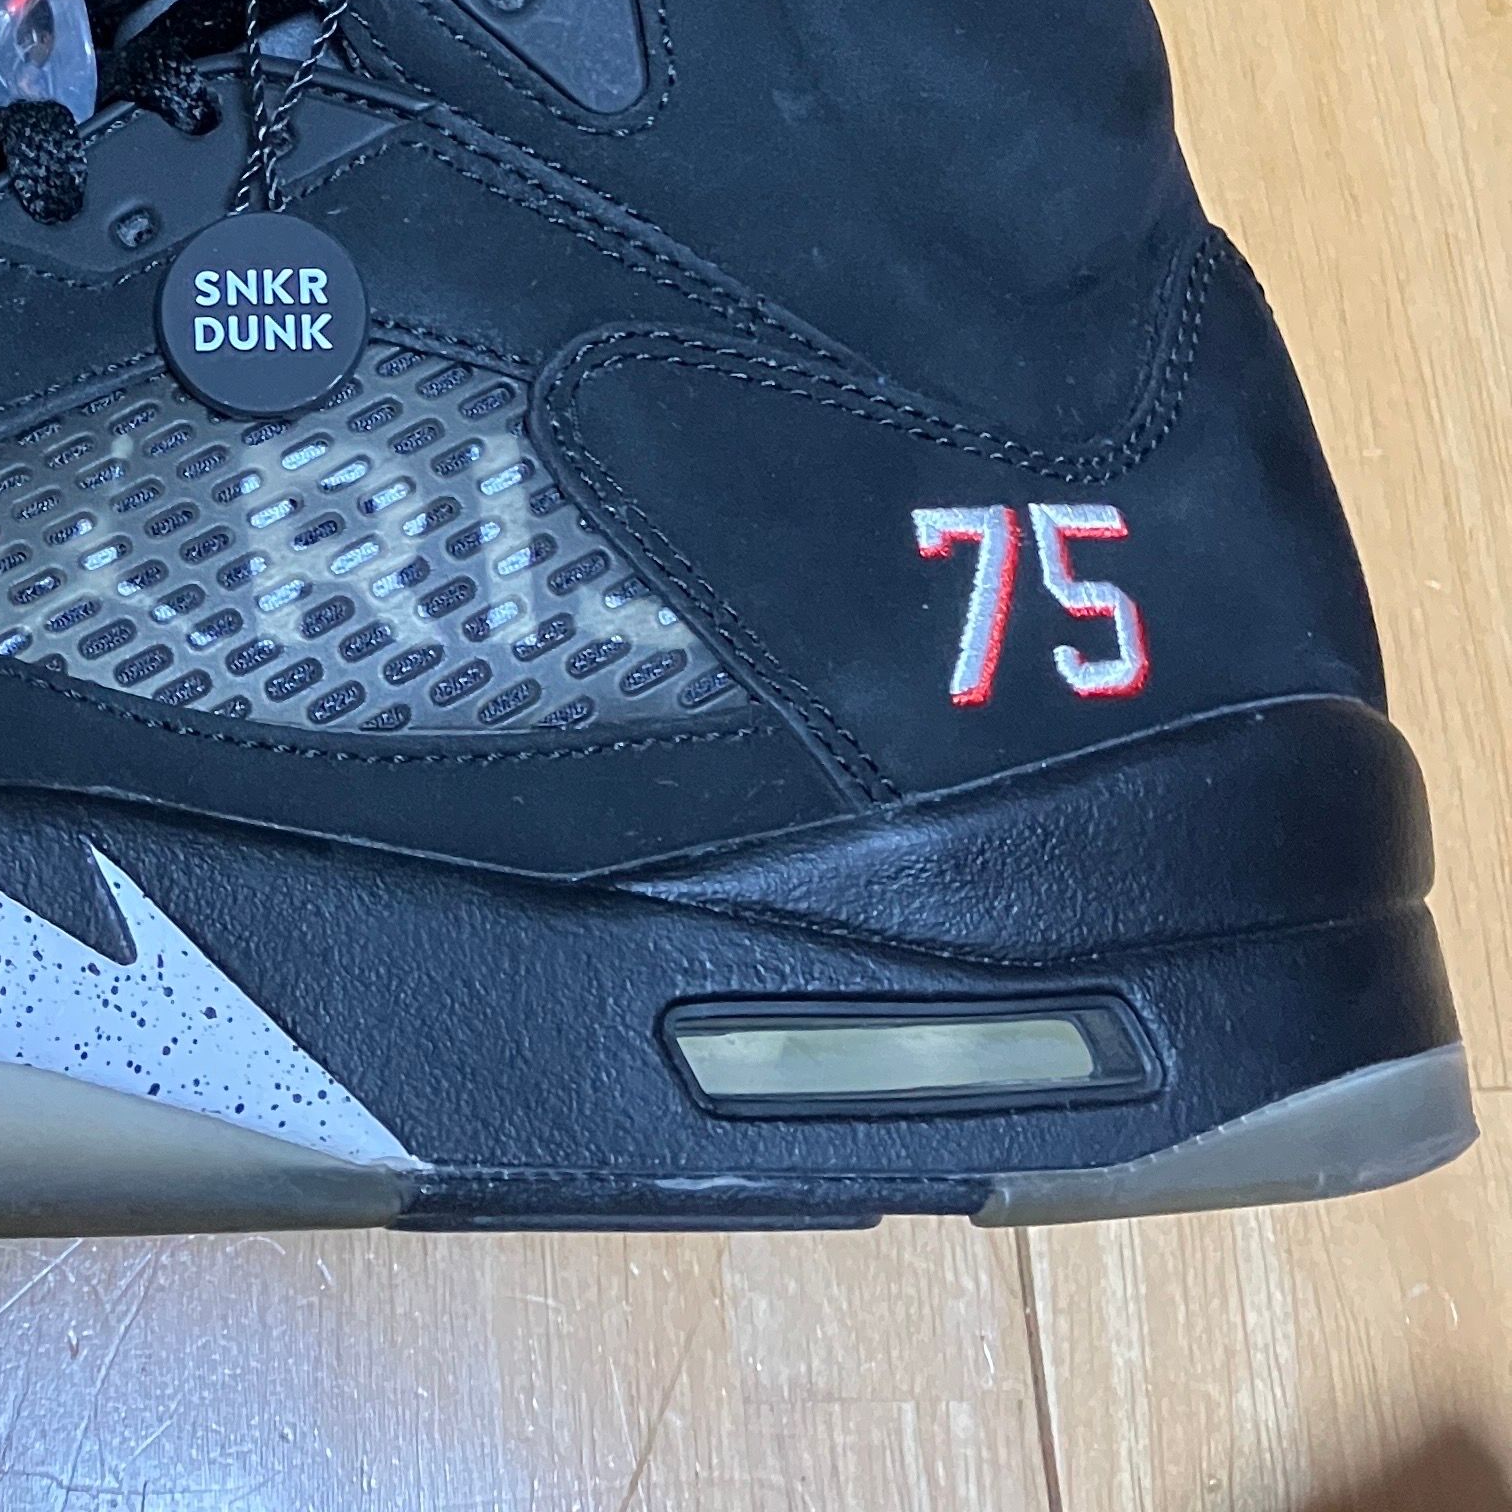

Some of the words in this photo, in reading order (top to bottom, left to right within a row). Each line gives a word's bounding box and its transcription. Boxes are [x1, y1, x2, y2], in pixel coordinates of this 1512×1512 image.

[194, 267, 329, 306] SNKR
[194, 313, 334, 352] DUNK
[911, 502, 1150, 706] 75
